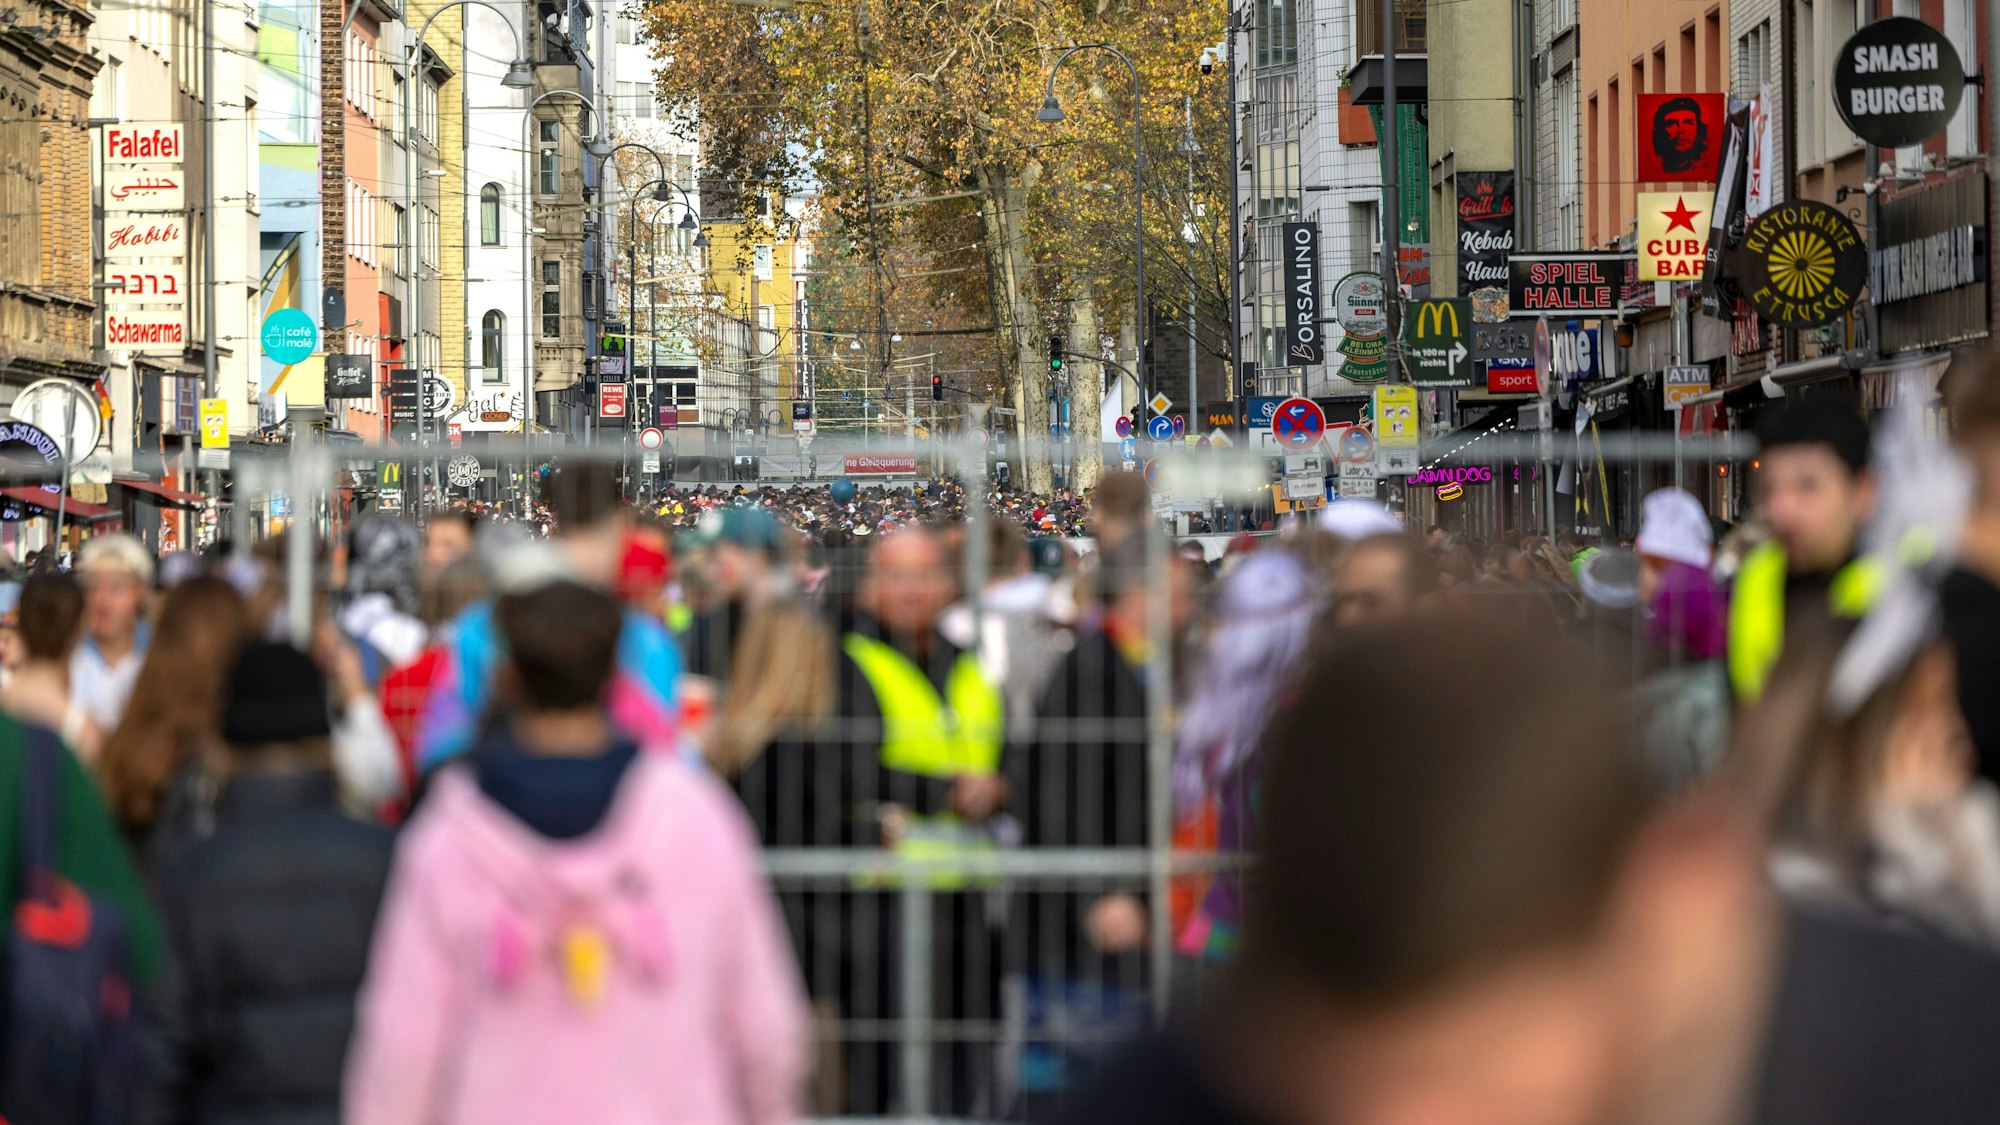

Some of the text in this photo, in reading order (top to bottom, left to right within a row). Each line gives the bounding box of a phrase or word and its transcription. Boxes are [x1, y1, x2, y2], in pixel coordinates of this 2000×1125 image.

[1854, 42, 1939, 74] SMASH
[1851, 84, 1946, 116] BURGER
[109, 130, 178, 157] Falafel
[110, 178, 178, 201] حبيبي
[108, 223, 179, 250] Habibi
[1746, 206, 1855, 254] RISTORANTE
[1461, 230, 1513, 254] Kebab
[1465, 261, 1509, 281] Haus
[1531, 263, 1605, 284] SPIEL
[1291, 228, 1315, 361] BORSALINO
[1525, 287, 1611, 308] HALLE
[109, 316, 182, 343] Schawarma
[287, 327, 311, 336] café
[286, 338, 313, 348] malé
[1344, 345, 1387, 355] KLEINMAN
[1351, 340, 1364, 348] BEI
[338, 367, 360, 376] Gaffel
[1420, 359, 1446, 367] rechts
[1499, 375, 1532, 387] sport
[1669, 368, 1708, 382] ATM
[859, 457, 915, 468] Gleisquerung
[1456, 466, 1492, 482] DOG
